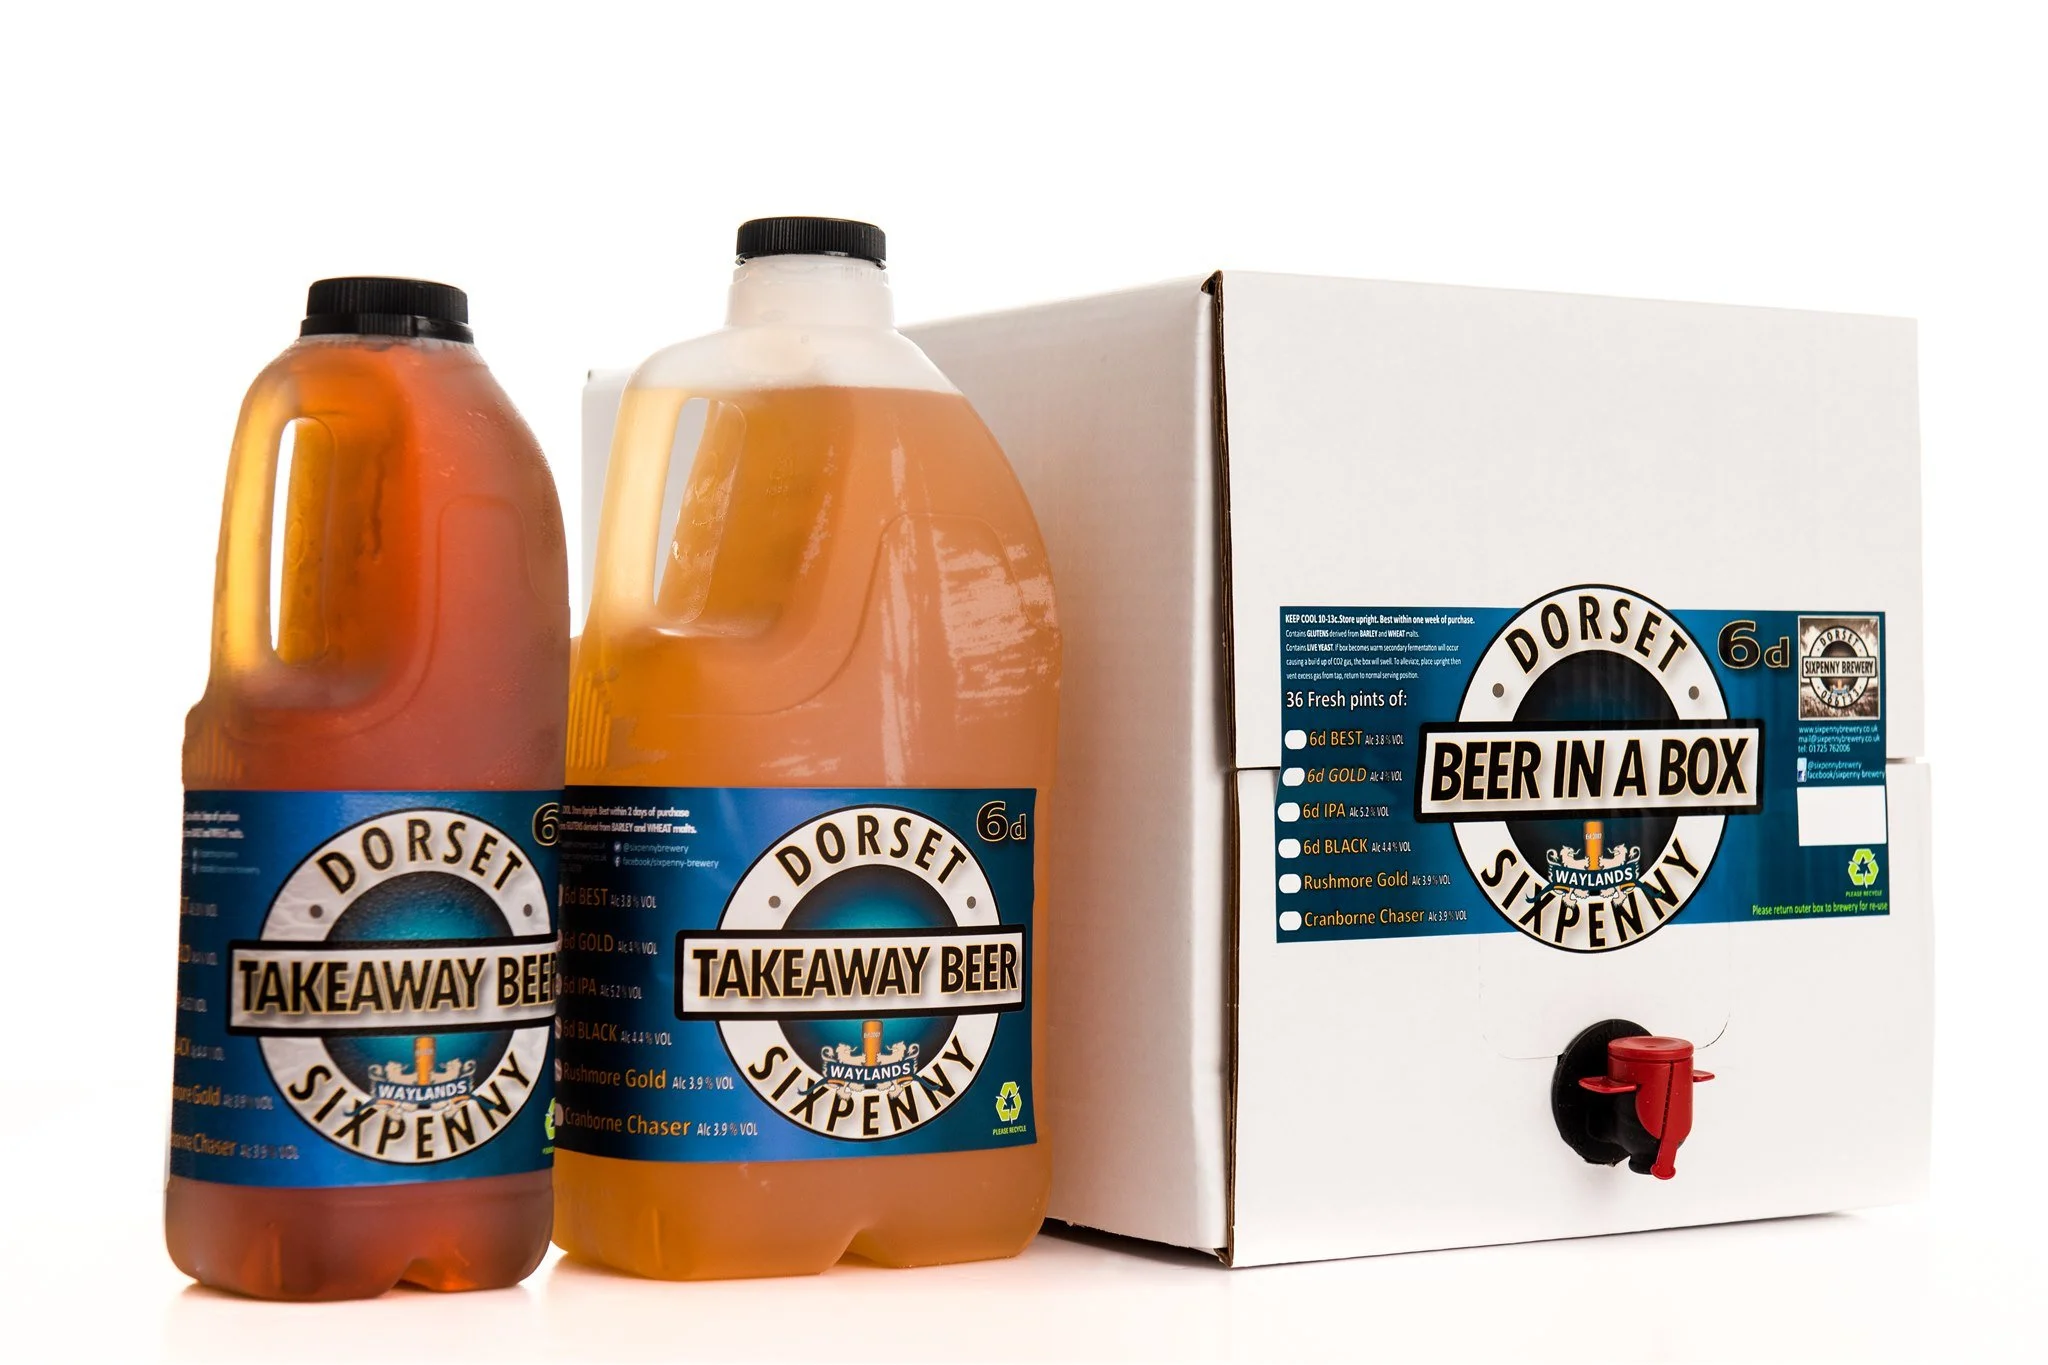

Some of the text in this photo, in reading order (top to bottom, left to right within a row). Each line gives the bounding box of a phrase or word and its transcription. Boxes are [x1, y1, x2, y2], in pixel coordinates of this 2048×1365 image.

[1285, 614, 1300, 623] KEEP
[1301, 615, 1317, 623] COOL
[1356, 614, 1379, 625] upright.
[1380, 615, 1392, 623] Best
[1394, 614, 1412, 623] within
[1425, 615, 1440, 623] week
[1441, 615, 1447, 623] of
[1448, 615, 1475, 625] purchase.
[1360, 630, 1377, 638] BARLEY
[1505, 596, 1687, 674] DORSET
[1820, 629, 1859, 647] DORSET
[1384, 644, 1407, 652] secondary
[1718, 620, 1790, 669] 6d
[1286, 658, 1303, 667] causing
[1421, 658, 1433, 666] place
[1434, 658, 1450, 666] upright
[1805, 660, 1874, 674] SIXPENNY BREWERY
[1322, 671, 1333, 679] from
[1366, 671, 1381, 679] normal
[1382, 672, 1399, 680] serving
[1286, 689, 1407, 710] 36 Fresh pints of:
[1309, 730, 1404, 746] 6d BEST Alc 3.8 VOL
[1808, 744, 1850, 752] 01725 762006
[1307, 767, 1402, 783] 6d GOLD Alc 4 VOL
[1430, 736, 1749, 802] BEER IN A BOX
[628, 807, 690, 819] 2 days of purchase
[1302, 803, 1389, 818] 6d IPA Alc 5.2 VOL
[532, 802, 560, 846] 6
[611, 823, 697, 834] BARLEY and WHEAT malts.
[975, 800, 1027, 844] 6d
[316, 818, 523, 894] DORSET
[623, 843, 689, 854] @sixpennybrewery
[773, 812, 968, 889] DORSET
[1303, 838, 1411, 855] 6d BLACK Alc 4.4 VOL
[622, 857, 719, 869] facebook/sixpenny-brewery
[1304, 871, 1450, 890] Rushmore Gold Alc 3.9 VOL
[1556, 867, 1633, 886] WAYLANDS
[579, 888, 657, 908] BEST VOL
[1480, 837, 1700, 949] SIXPENNY
[1304, 908, 1467, 927] Cranborne Chaser Alc 3.9 VOL
[1752, 905, 1774, 916] Please
[1794, 904, 1811, 914] outer
[1812, 902, 1823, 912] box
[1825, 903, 1832, 912] to
[1833, 902, 1858, 913] brewery
[1860, 901, 1868, 911] for
[1869, 902, 1888, 910] re-use
[578, 933, 658, 955] GOLD VOL
[691, 941, 1019, 1000] TAKEAWAY BEER
[238, 957, 487, 1016] TAKEAWAY
[578, 978, 642, 999] IPA VOL
[578, 1021, 672, 1046] BLACK VOL
[564, 1064, 734, 1090] Rushmore Gold Alc 3.9 VOL
[830, 1062, 911, 1081] WAYLANDS
[378, 1080, 467, 1101] WAYLANDS
[747, 1033, 976, 1137] SIXPENNY
[193, 1084, 222, 1107] Gold
[288, 1051, 532, 1160] SIXPENNY
[564, 1108, 758, 1136] Cranborne Chaser Alc 3.9 VOL
[992, 1125, 1027, 1136] PLEASE RECYCLE
[193, 1133, 237, 1157] Chaser
